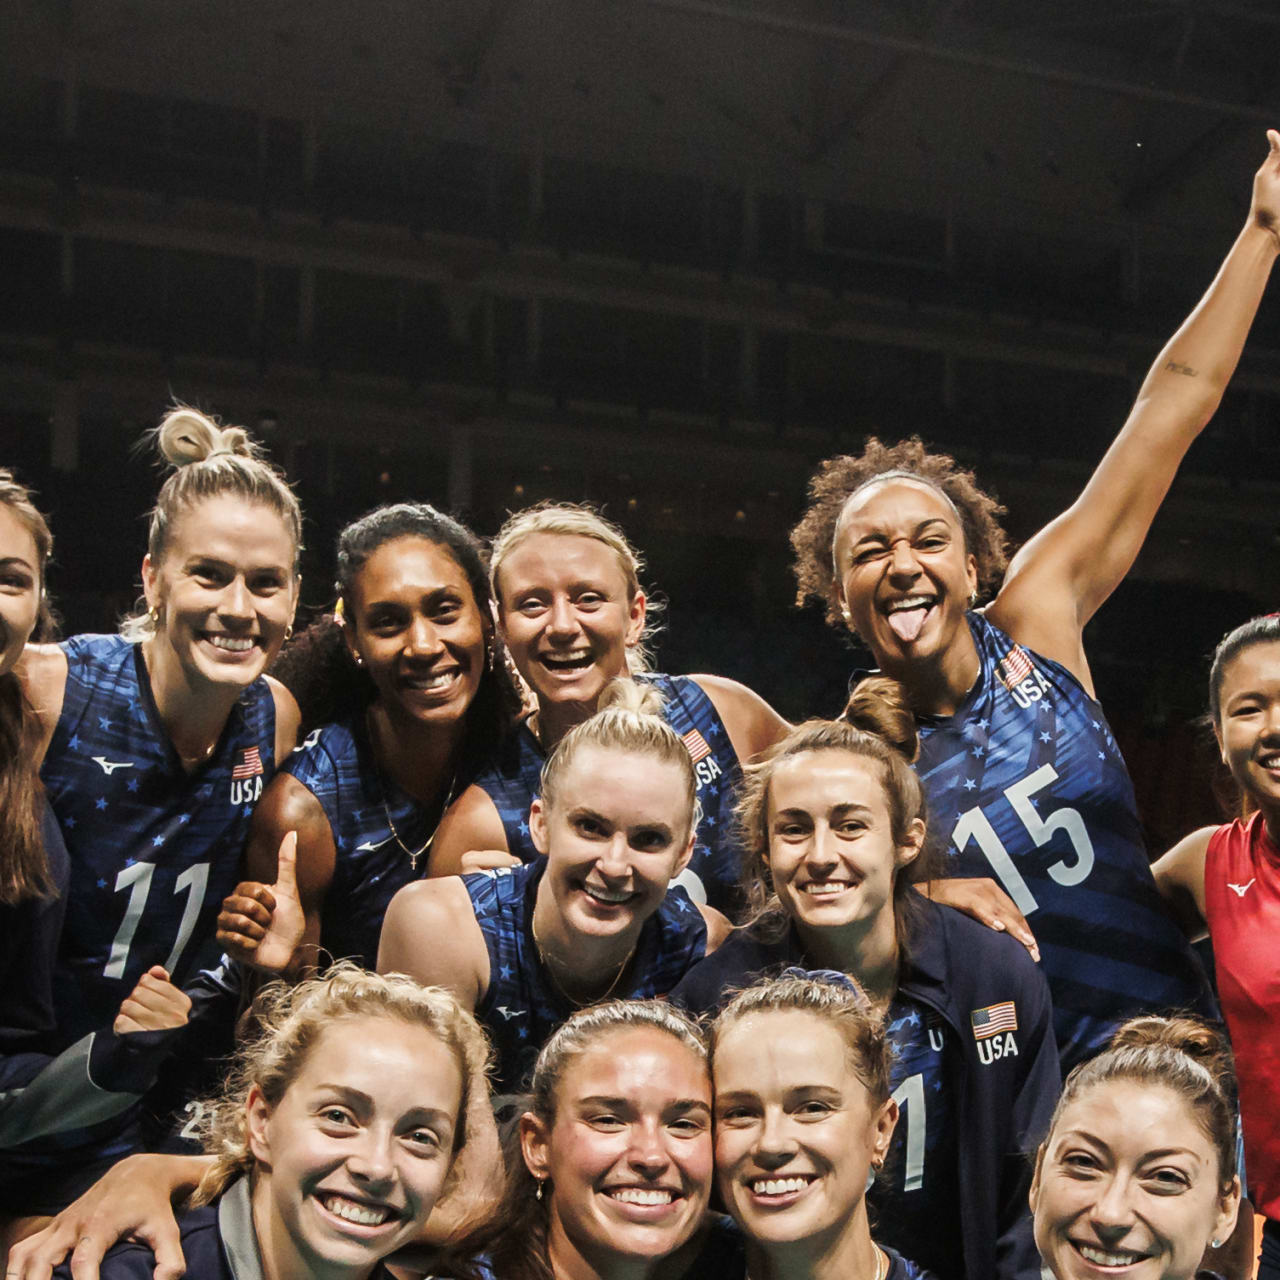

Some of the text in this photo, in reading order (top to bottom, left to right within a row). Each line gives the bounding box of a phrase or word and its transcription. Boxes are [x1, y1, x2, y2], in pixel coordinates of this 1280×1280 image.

[1012, 668, 1052, 711] USA
[231, 775, 263, 805] USA
[951, 762, 1096, 917] 15
[102, 861, 211, 979] 11
[976, 1032, 1018, 1065] USA
[882, 1073, 926, 1192] 1
